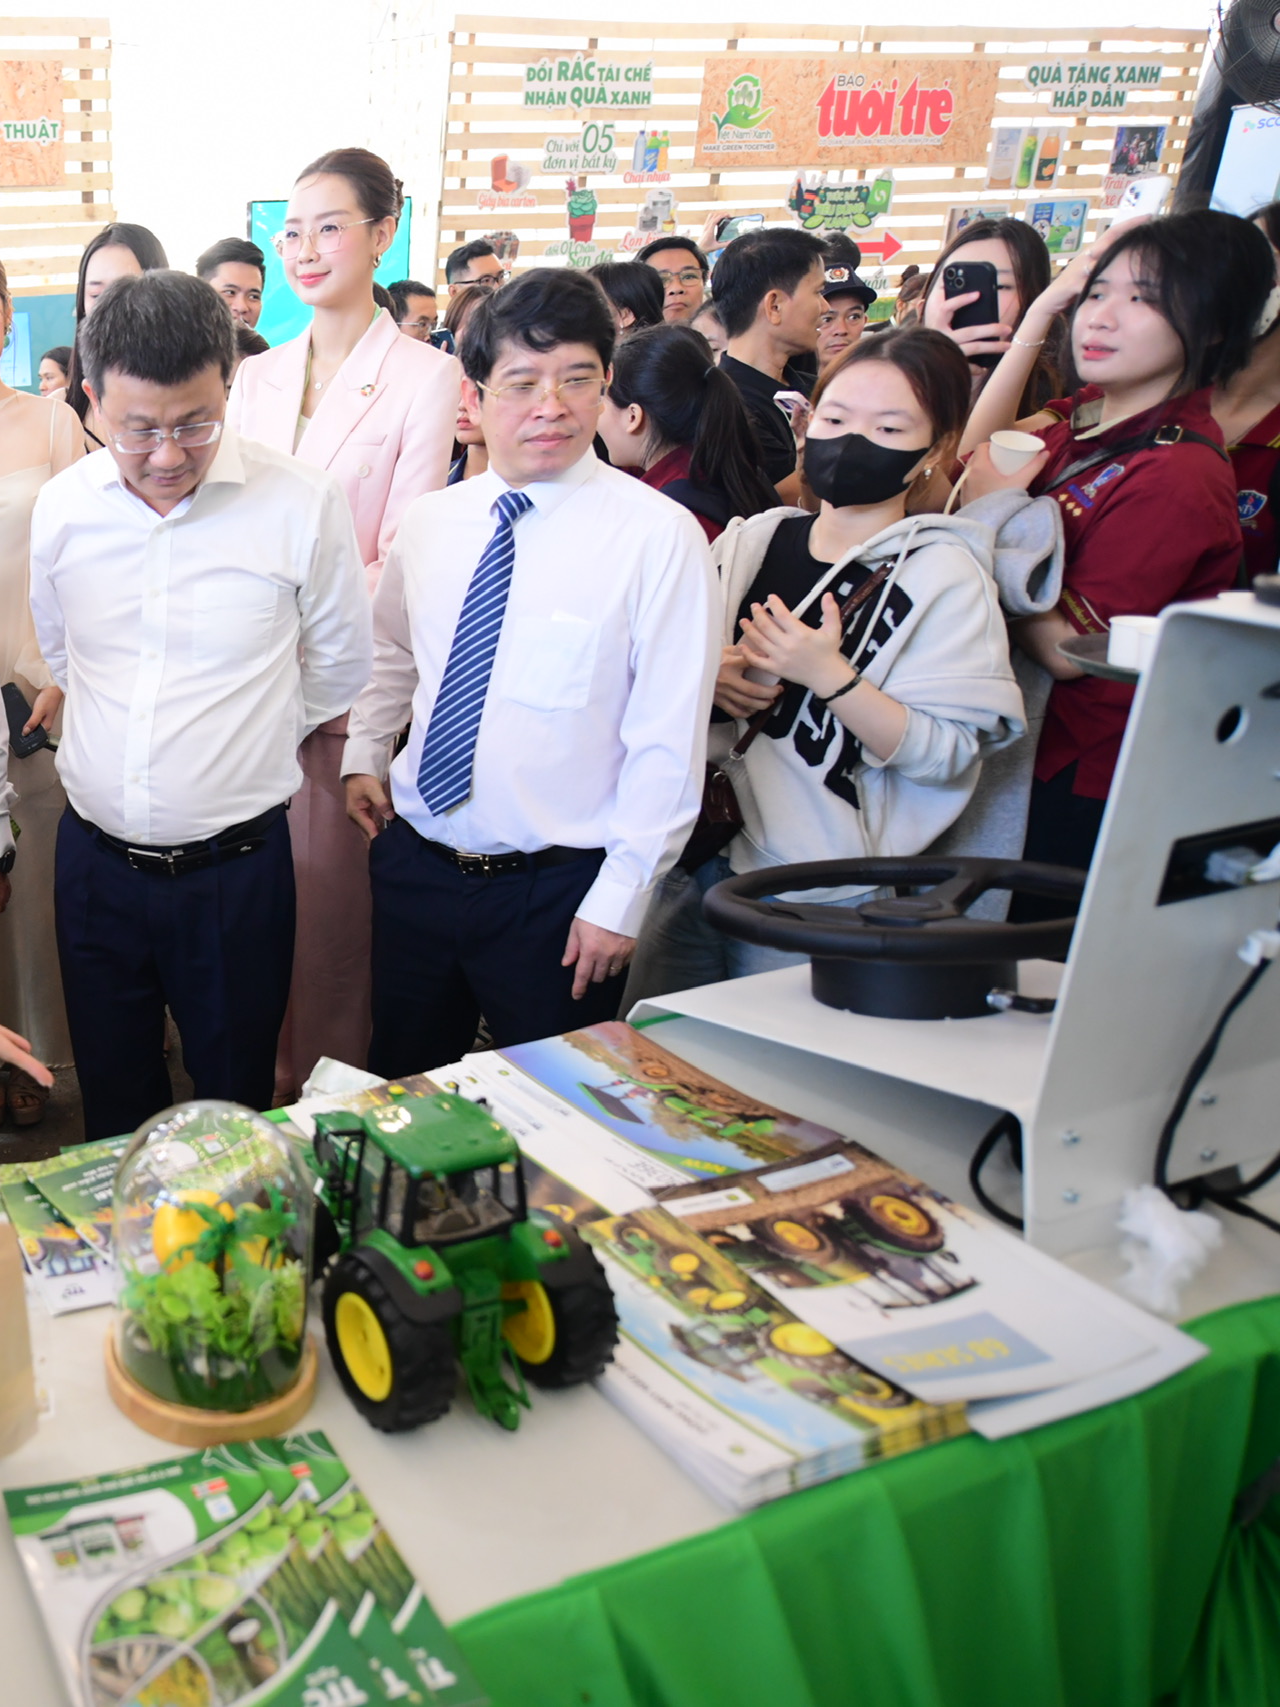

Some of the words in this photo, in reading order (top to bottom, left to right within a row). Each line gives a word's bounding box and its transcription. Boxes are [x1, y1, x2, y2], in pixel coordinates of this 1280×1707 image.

[557, 56, 596, 81] RÁC
[597, 64, 620, 82] TÁI
[624, 61, 653, 82] CHẾ
[1113, 66, 1161, 84] XANH
[524, 88, 567, 109] NHẬN
[570, 82, 607, 108] QUÀ
[610, 91, 652, 105] XANH
[1052, 84, 1087, 107] HẤP
[1090, 84, 1126, 107] DẪN
[3, 119, 59, 144] THUẬT
[582, 124, 615, 154] 05
[622, 232, 642, 250] Lon
